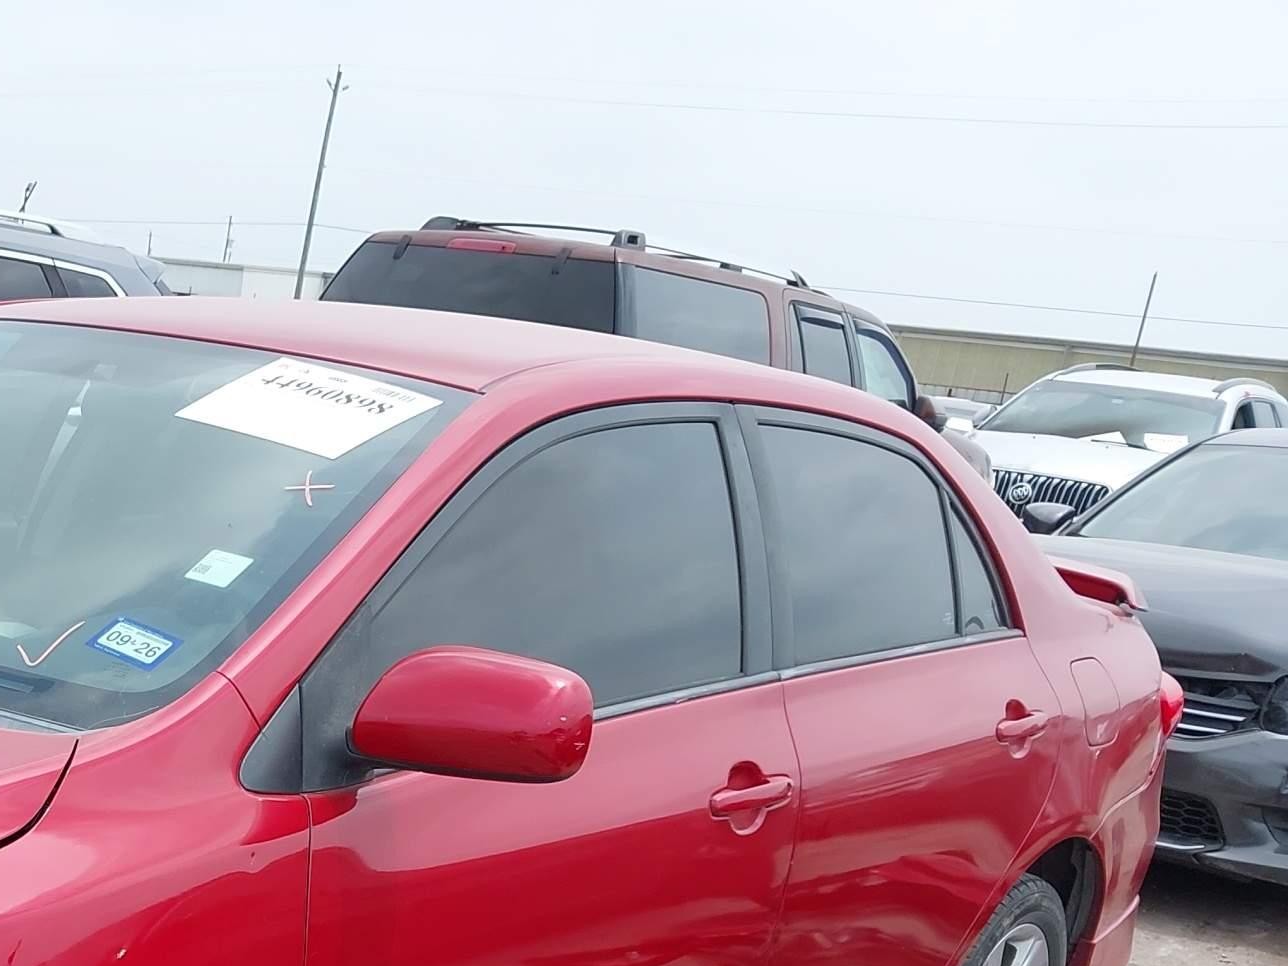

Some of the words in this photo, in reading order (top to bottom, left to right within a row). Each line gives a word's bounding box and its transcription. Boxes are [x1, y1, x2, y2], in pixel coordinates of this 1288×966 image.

[261, 374, 394, 415] 44960898
[106, 630, 132, 646] 09
[134, 641, 161, 658] 26
